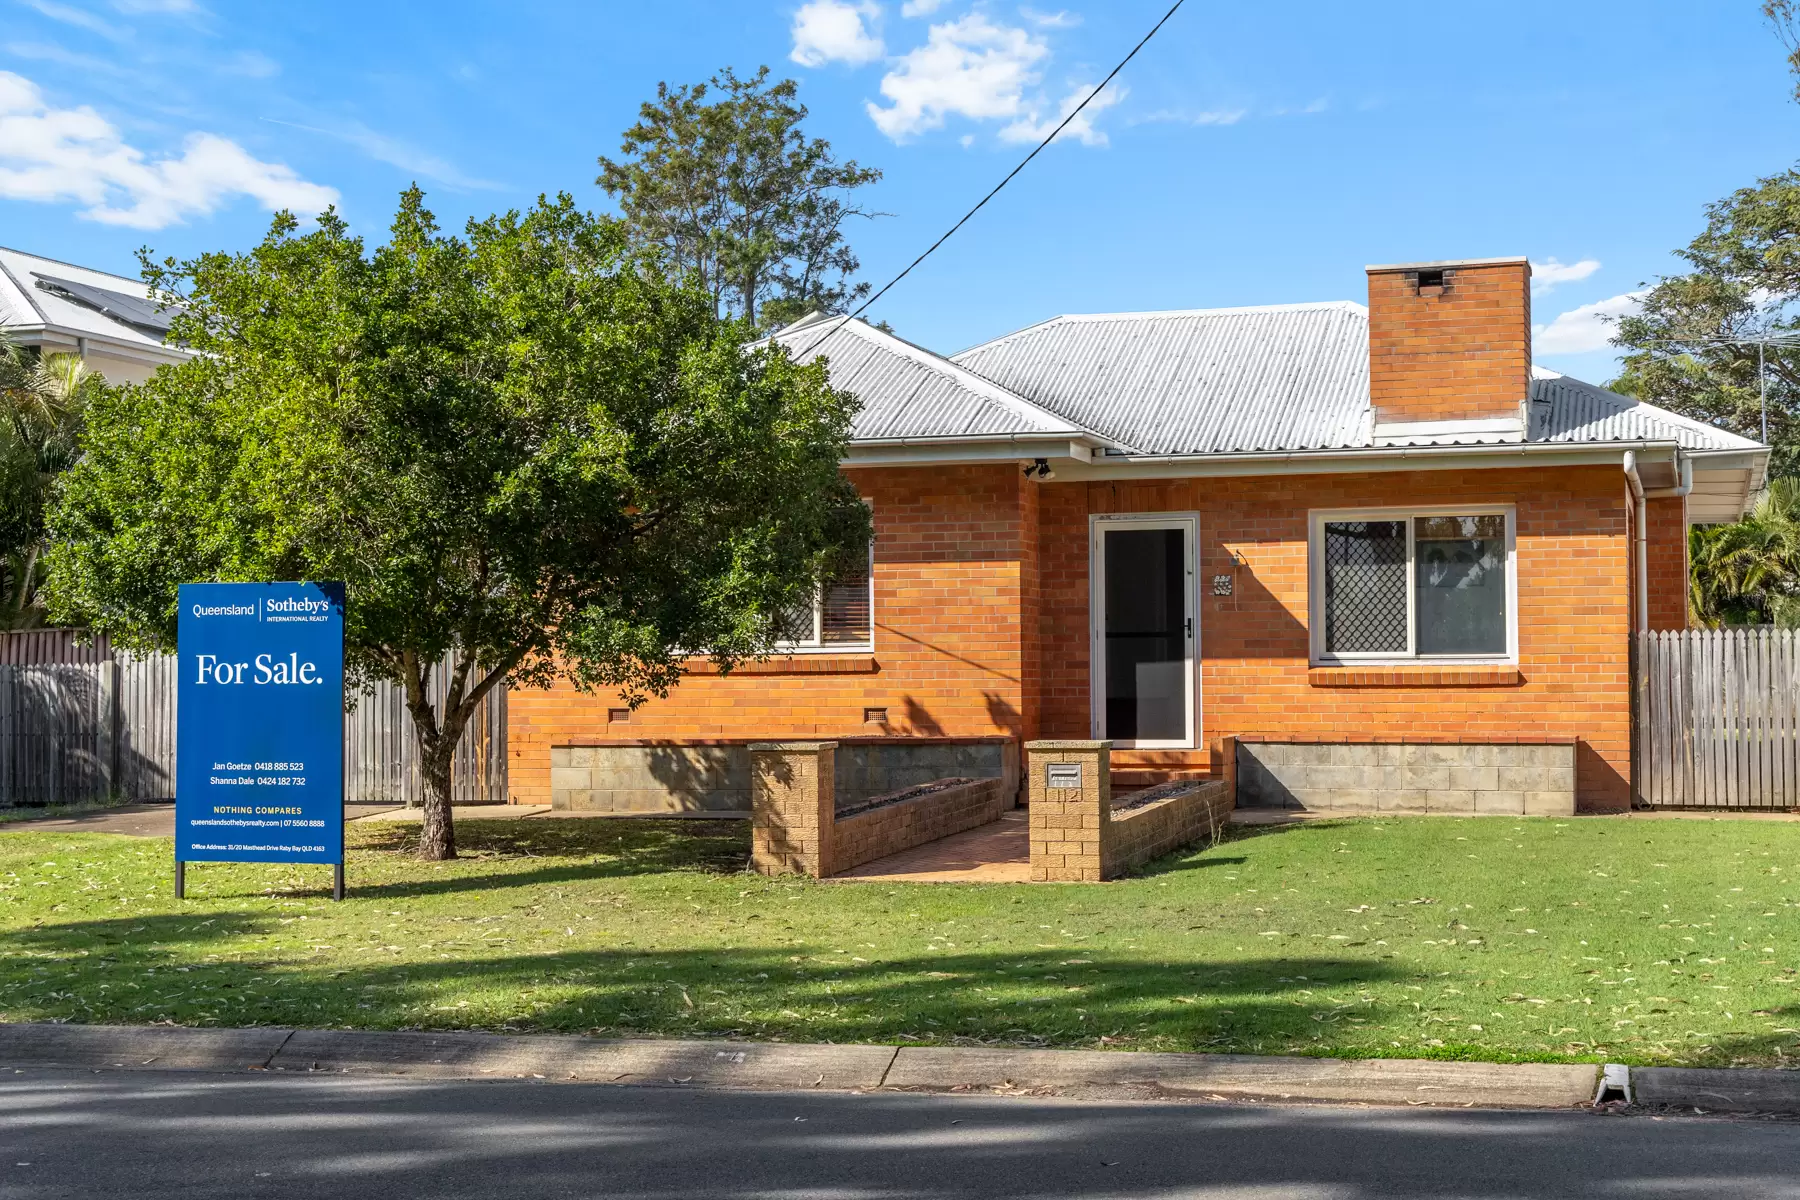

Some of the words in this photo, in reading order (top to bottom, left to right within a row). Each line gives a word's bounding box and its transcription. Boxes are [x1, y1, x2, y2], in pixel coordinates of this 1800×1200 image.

[193, 604, 254, 617] Queensland
[266, 597, 329, 614] Sotheby's
[195, 654, 249, 685] For
[254, 652, 323, 685] Sale.
[212, 762, 225, 770] Jan
[226, 762, 252, 771] Goetze
[254, 762, 273, 771] 0418
[274, 762, 288, 771] 885
[289, 762, 304, 771] 523
[210, 776, 237, 785] Shanna
[238, 777, 254, 786] Dale
[257, 777, 277, 786] 0424
[278, 778, 290, 786] 182
[292, 778, 306, 786] 732
[213, 806, 253, 814] NOTHING
[255, 806, 302, 815] COMPARES
[190, 819, 280, 828] queenslandsothebysrealty.com
